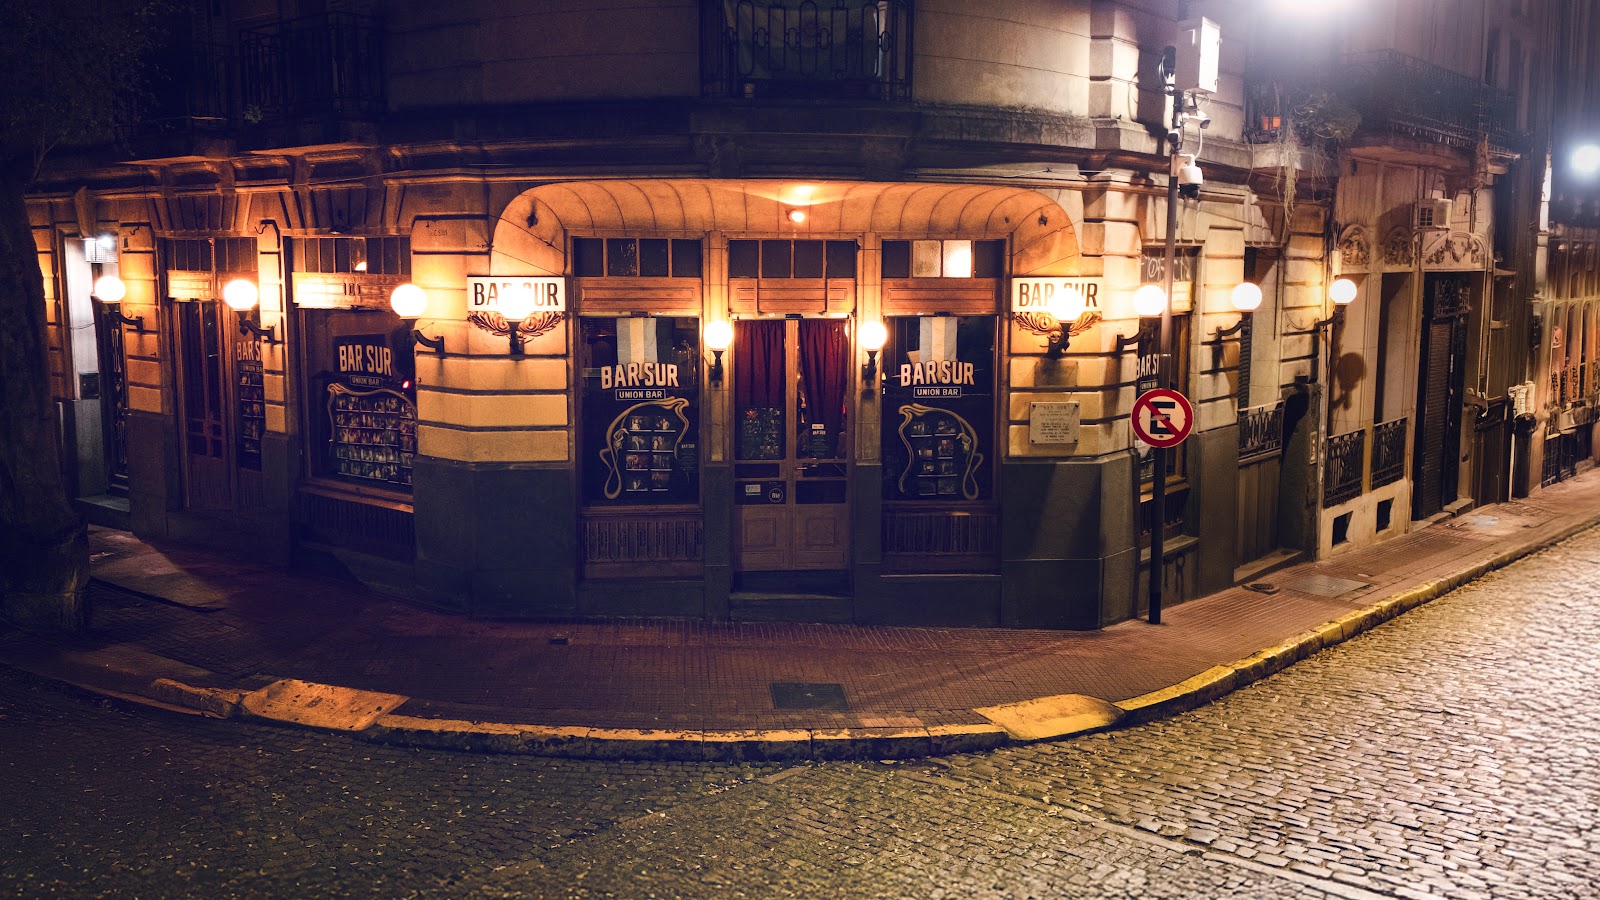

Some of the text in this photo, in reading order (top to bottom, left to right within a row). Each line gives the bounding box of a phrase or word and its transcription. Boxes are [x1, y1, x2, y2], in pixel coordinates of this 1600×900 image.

[473, 282, 559, 306] BA UR
[1063, 282, 1098, 307] UR
[236, 341, 254, 361] BAR
[339, 344, 392, 377] BAR SUR
[601, 362, 680, 390] BAR SUR
[900, 360, 975, 387] BAR SUR
[1136, 354, 1151, 379] BAR
[351, 377, 380, 386] UNION BAR
[916, 388, 959, 396] UNION BAR
[619, 390, 663, 399] UNION BAR
